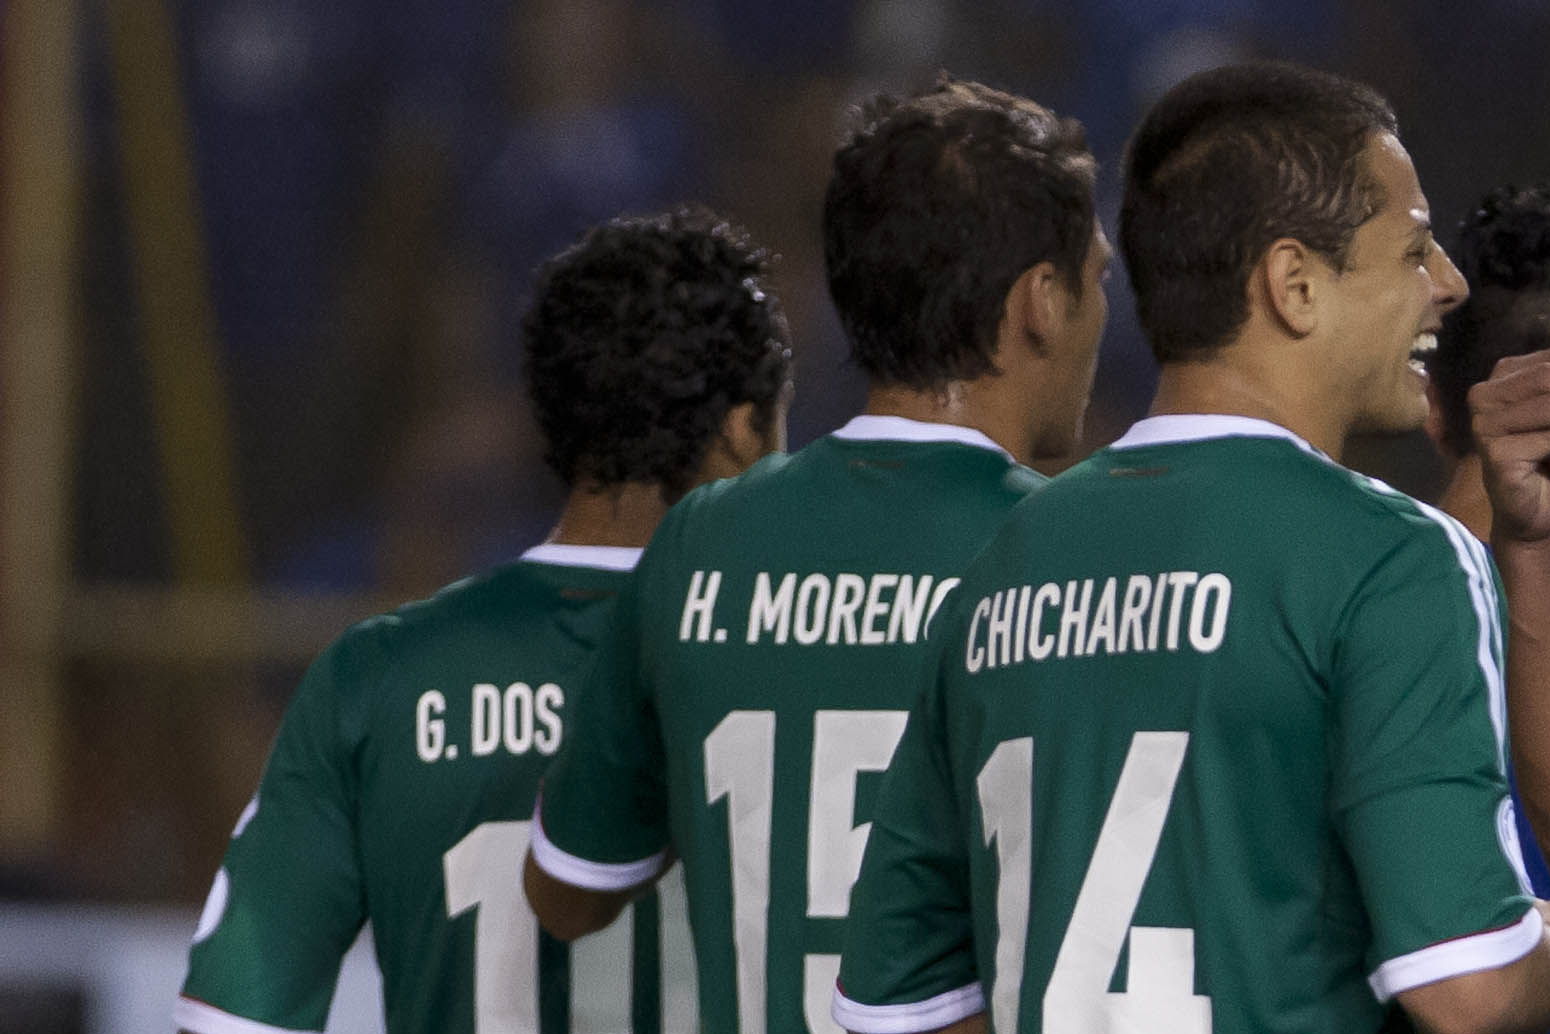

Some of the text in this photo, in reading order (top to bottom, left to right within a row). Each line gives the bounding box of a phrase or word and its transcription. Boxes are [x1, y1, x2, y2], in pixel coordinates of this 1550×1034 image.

[679, 571, 728, 643] H.
[966, 571, 1231, 673] CHICHARITO
[416, 682, 564, 762] G. DOS
